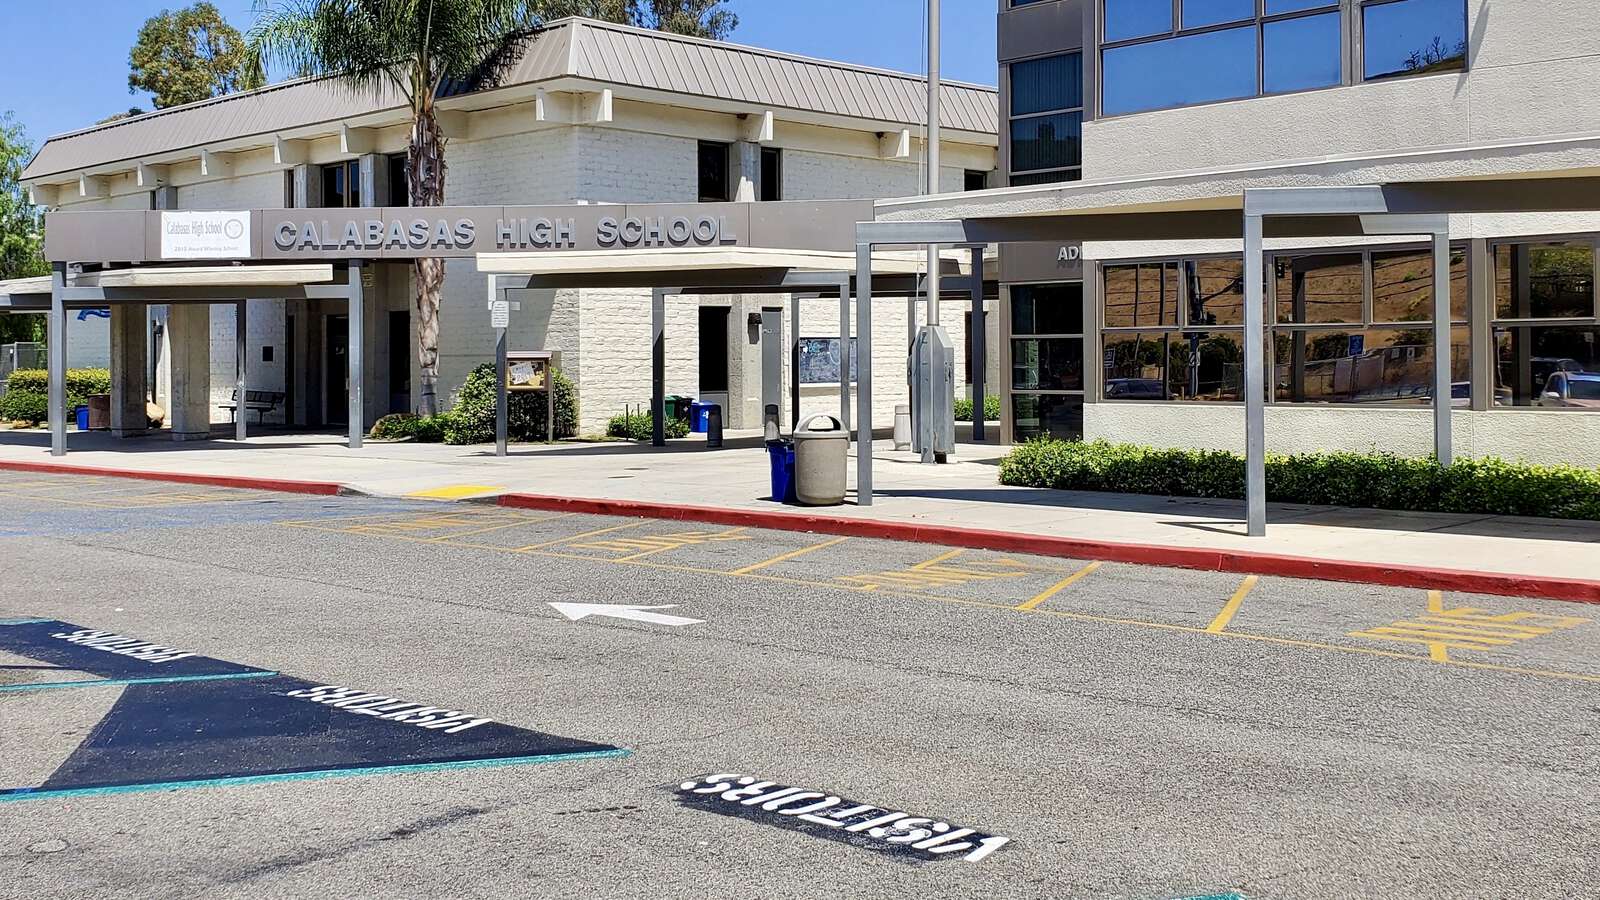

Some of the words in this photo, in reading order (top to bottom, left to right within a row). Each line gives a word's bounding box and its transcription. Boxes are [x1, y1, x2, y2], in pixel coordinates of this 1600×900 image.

[166, 219, 191, 235] Calabasas
[191, 219, 204, 237] High
[204, 219, 223, 234] School
[274, 218, 476, 250] CALABASAS
[496, 216, 575, 249] HIGH
[596, 215, 737, 247] SCHOOL
[1057, 245, 1082, 261] AD
[51, 629, 197, 664] VISITORS
[287, 685, 493, 734] VISITORS
[680, 773, 1011, 863] VISITORS
